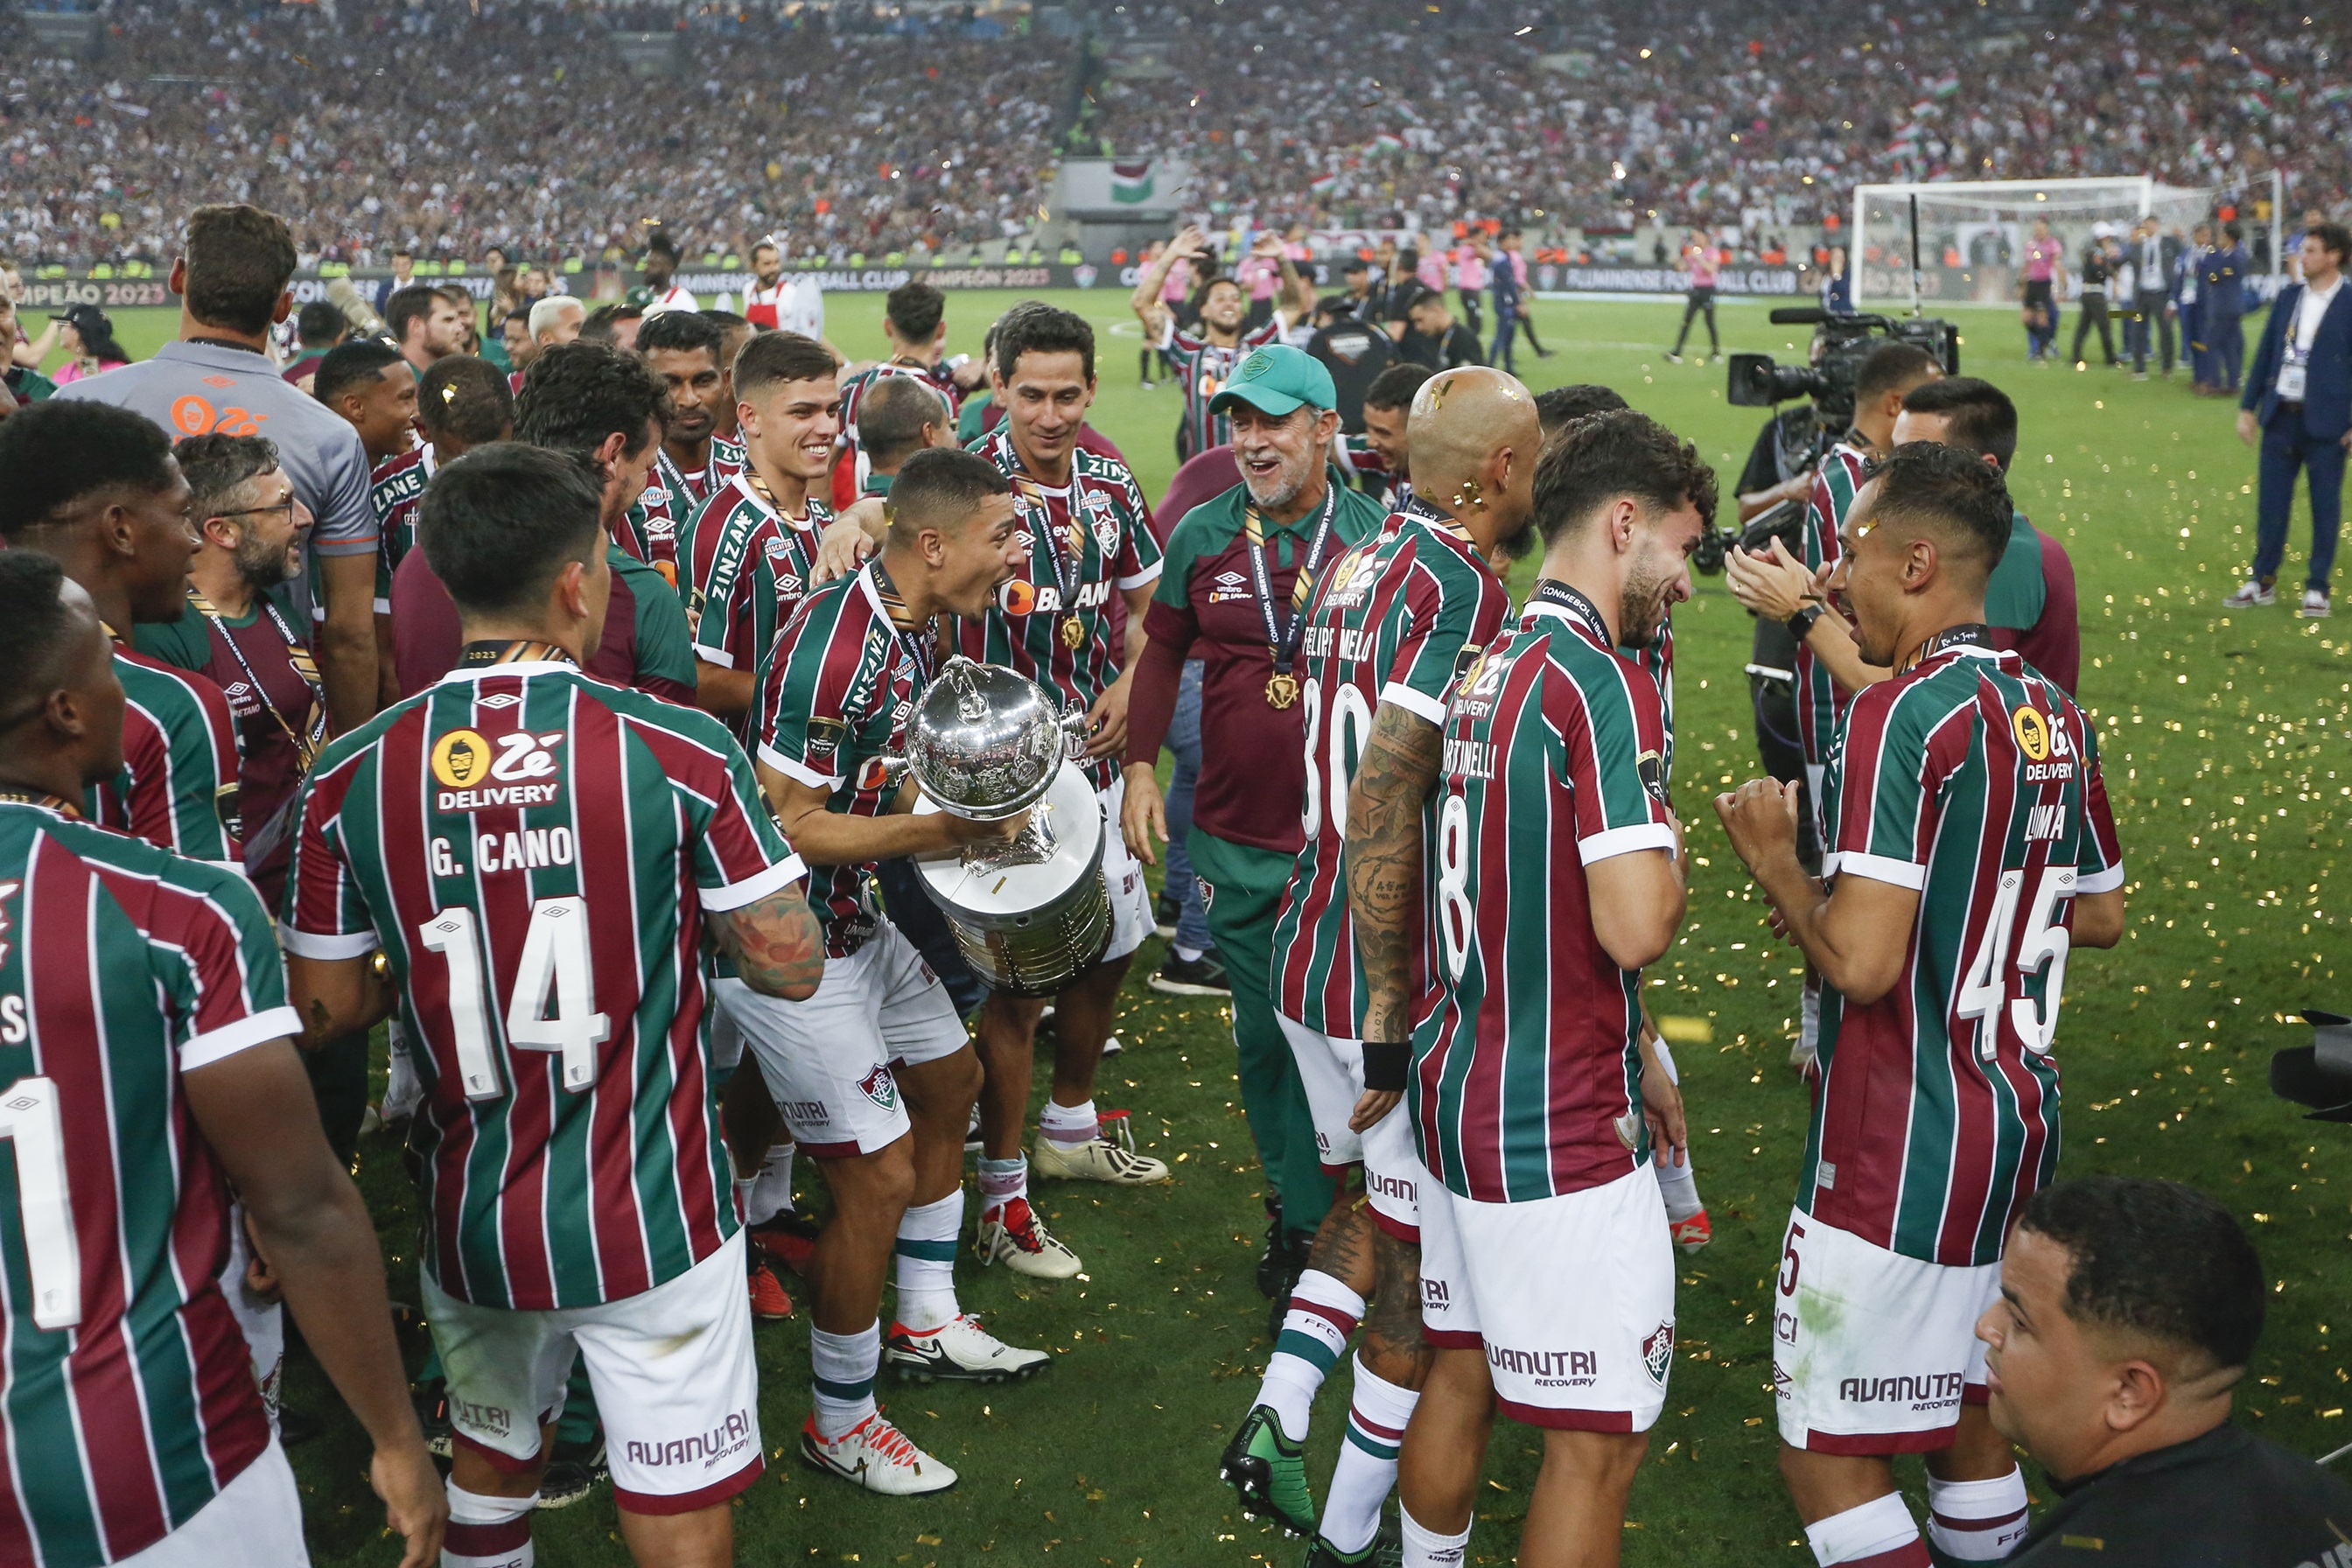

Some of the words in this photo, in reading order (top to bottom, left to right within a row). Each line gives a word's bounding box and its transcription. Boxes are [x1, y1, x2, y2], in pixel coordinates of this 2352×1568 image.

[21, 279, 101, 306] MPEÃO
[105, 283, 166, 305] 2023
[373, 473, 421, 513] ZANE
[647, 532, 676, 542] umbro
[766, 540, 794, 554] RESCATTO
[711, 509, 753, 602] ZINZANE
[776, 591, 803, 602] umbro
[1542, 585, 1592, 618] CONMEBOL
[1590, 616, 1608, 647] LIBERT
[469, 650, 497, 661] 2023
[1302, 626, 1335, 658] FELIPE
[1338, 627, 1375, 662] MELO
[490, 732, 564, 781] Zé
[2026, 762, 2073, 781] DELIVERY
[438, 783, 558, 810] DELIVERY
[2023, 804, 2067, 842] LIMA
[430, 836, 464, 878] G.
[479, 825, 574, 875] CANO
[1957, 865, 2079, 1061] 45
[418, 895, 611, 1102] 14
[1374, 1011, 1382, 1041] LOVE
[1304, 1316, 1337, 1339] FFC
[1534, 1377, 1598, 1388] RECOVERY
[1839, 1369, 1966, 1403] AVANUTR
[1997, 1522, 2030, 1546] FF
